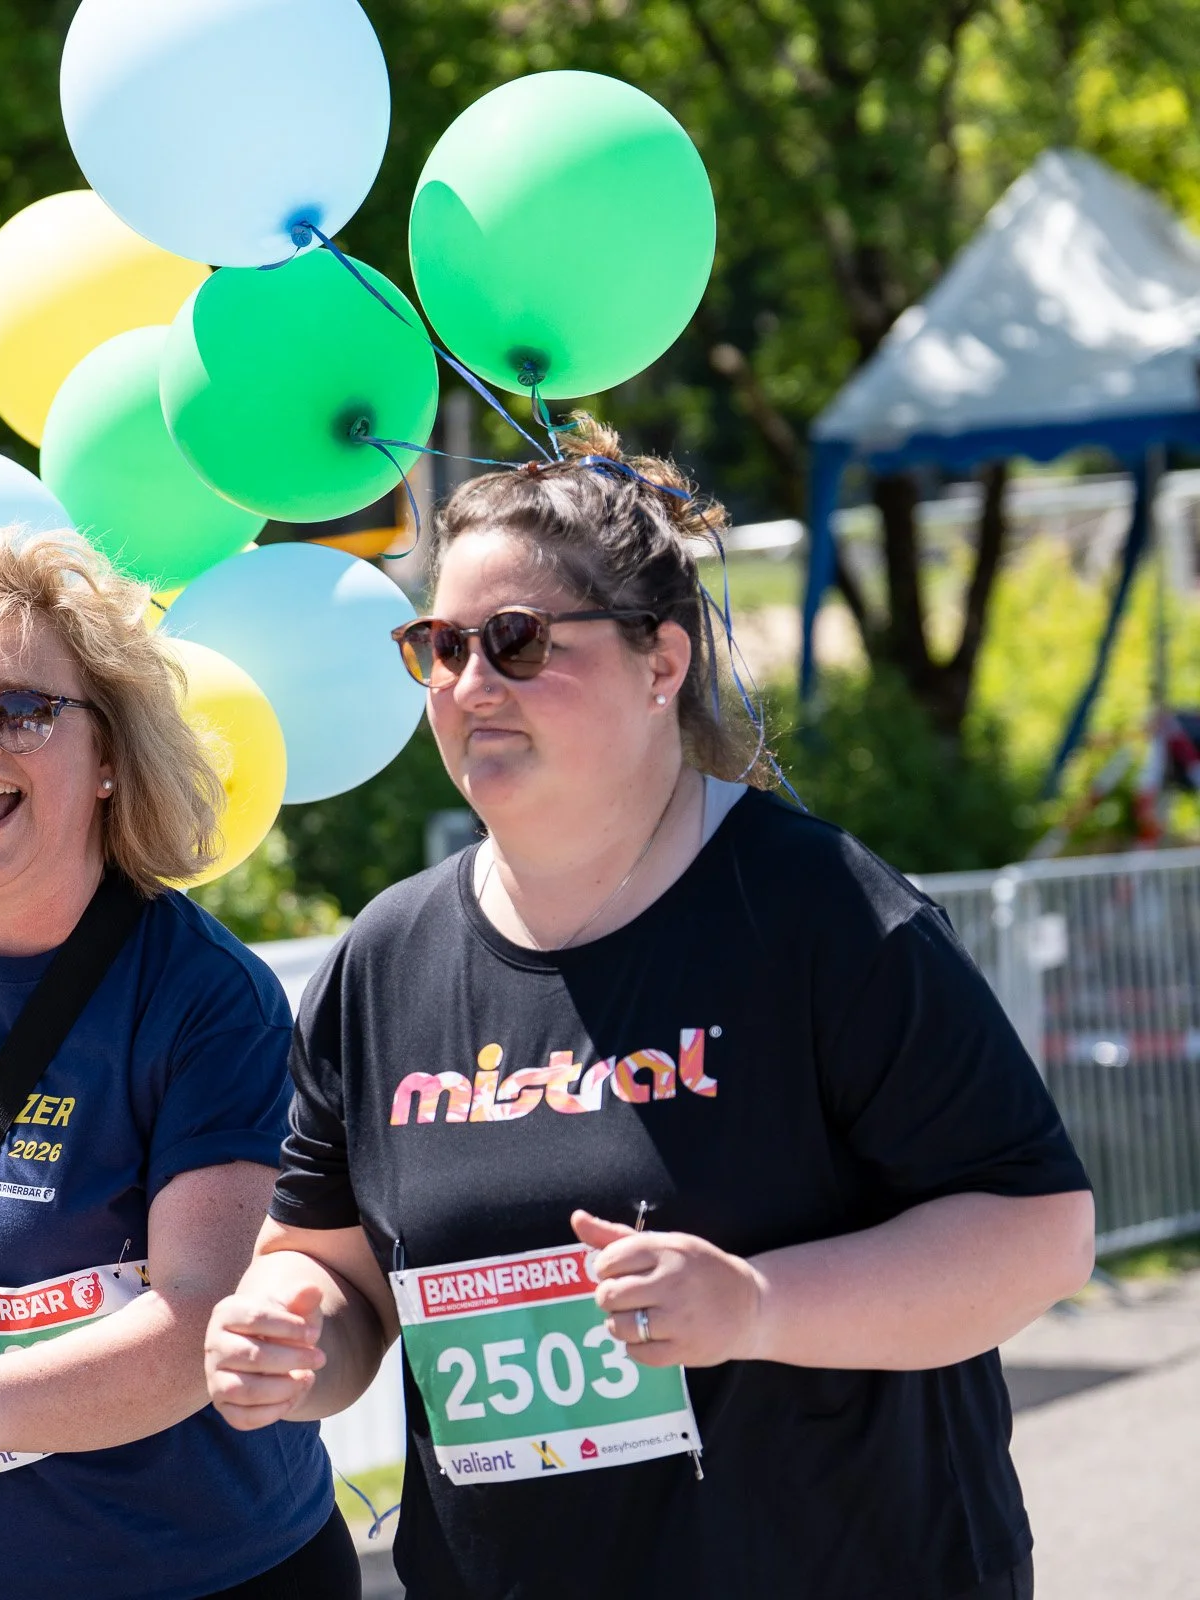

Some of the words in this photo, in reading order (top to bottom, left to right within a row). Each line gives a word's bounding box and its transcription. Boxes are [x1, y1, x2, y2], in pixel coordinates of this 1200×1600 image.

[390, 1028, 718, 1126] mistral
[8, 1140, 63, 1163] 2026
[423, 1257, 582, 1307] BÄRNERBÄR
[436, 1324, 640, 1422] 2503
[452, 1449, 516, 1475] valiant
[601, 1432, 678, 1454] easyhomes.ch
